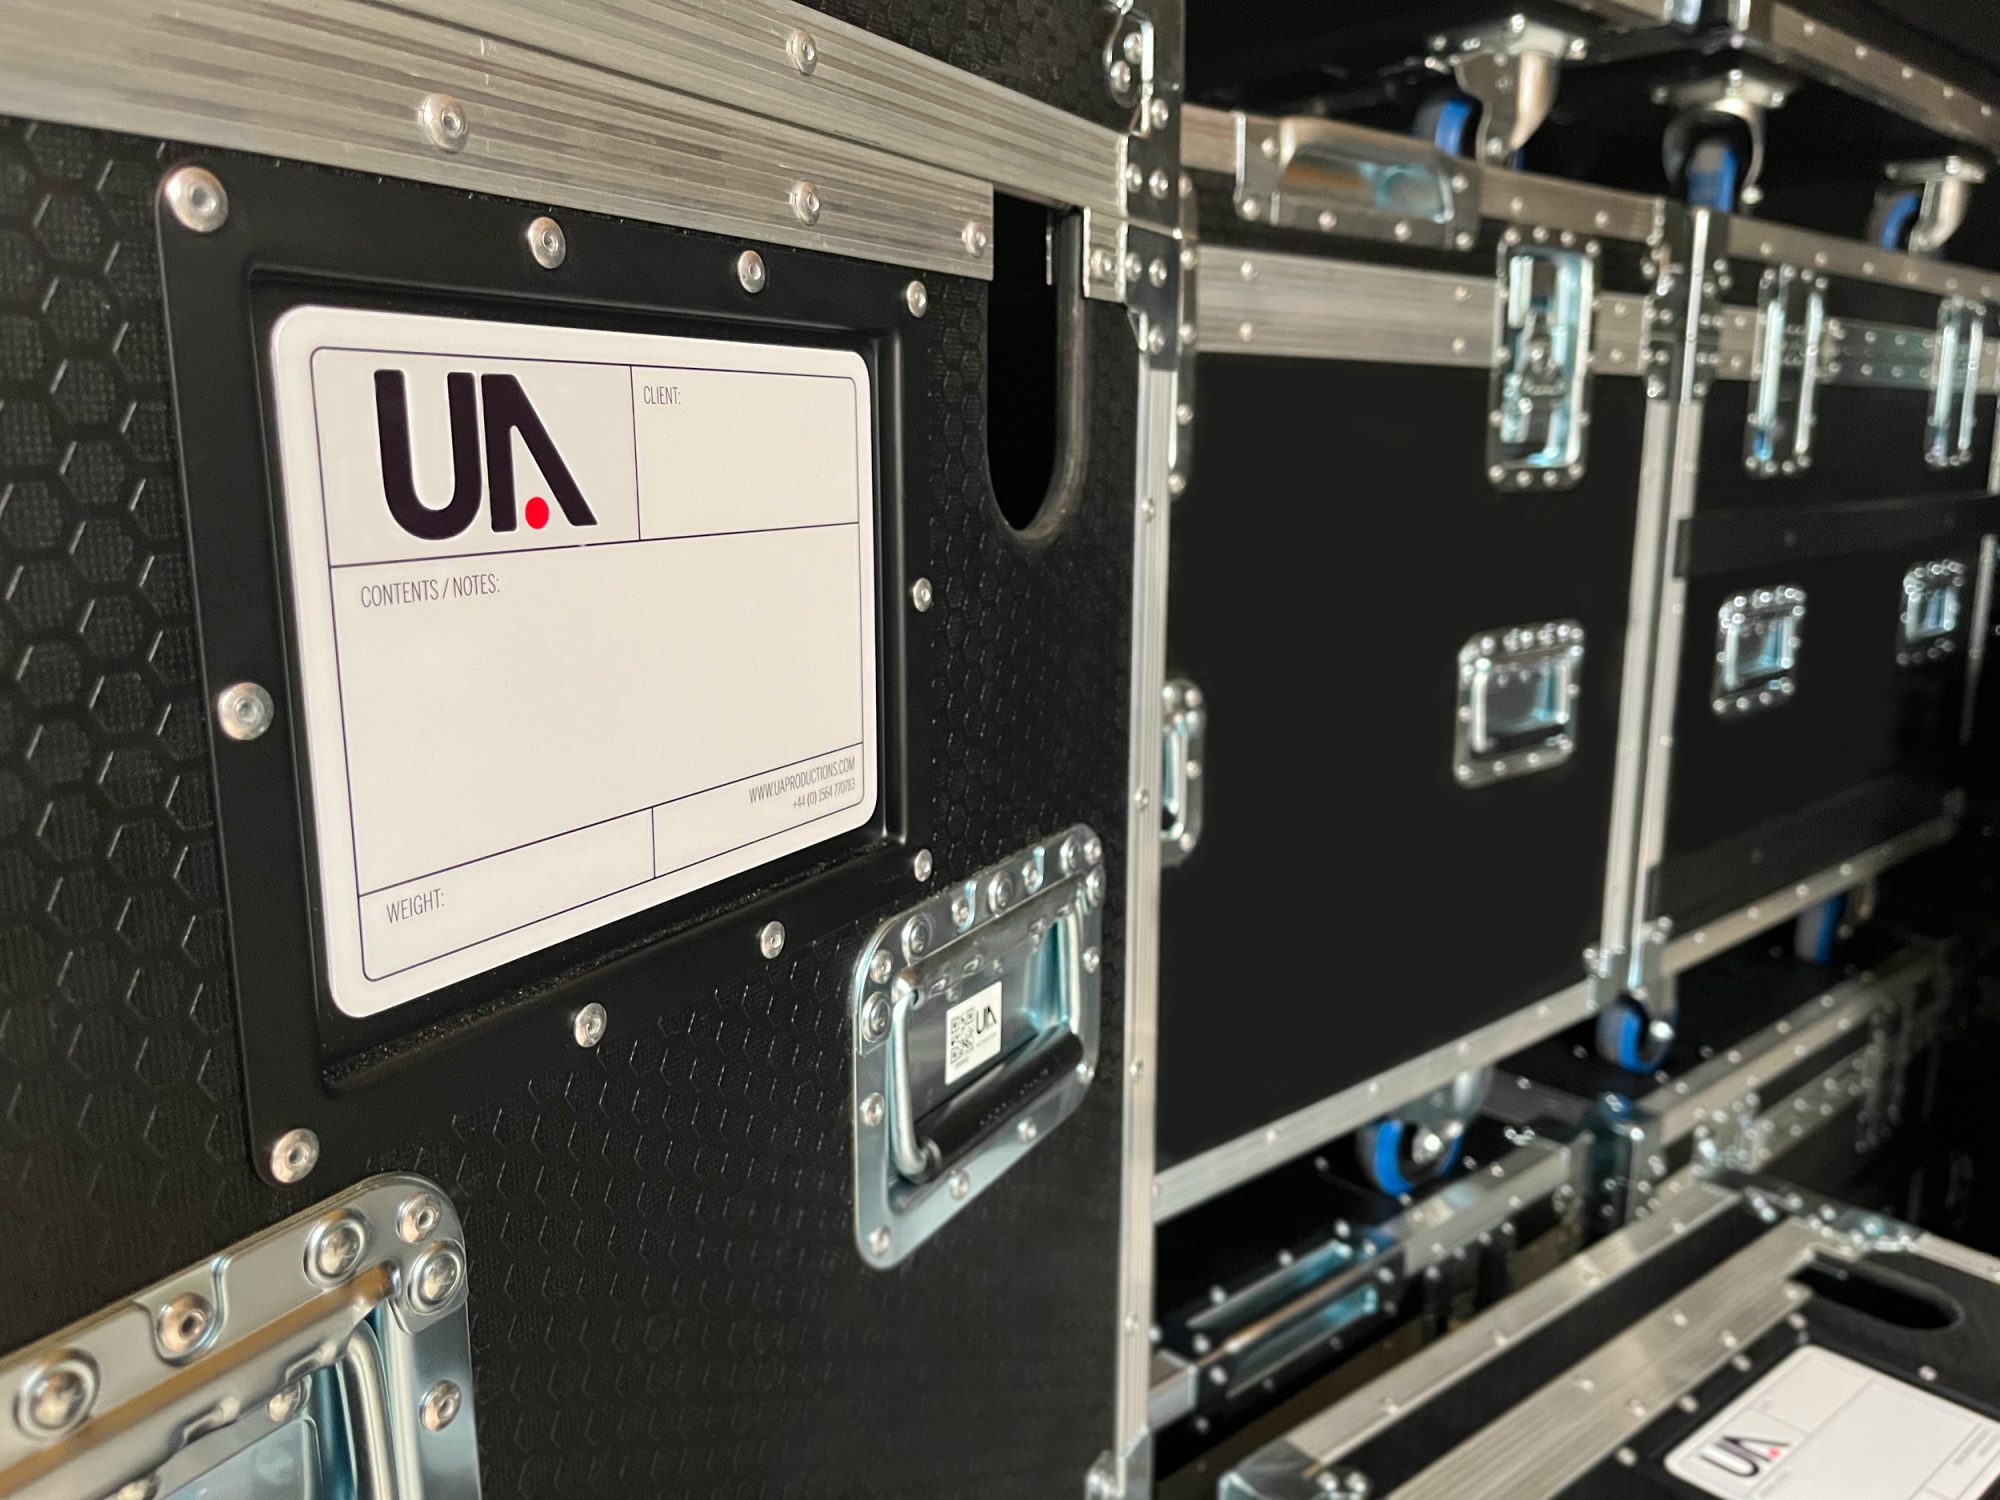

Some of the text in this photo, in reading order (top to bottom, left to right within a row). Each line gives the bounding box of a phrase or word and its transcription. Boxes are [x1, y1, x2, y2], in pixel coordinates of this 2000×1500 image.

[643, 385, 681, 405] CLIENT:
[374, 369, 598, 541] UA
[360, 573, 500, 608] CONTENTS / NOTES:
[749, 755, 856, 804] WWW.UAPRODUCTIONS.COM
[386, 887, 445, 924] WEIGHT:
